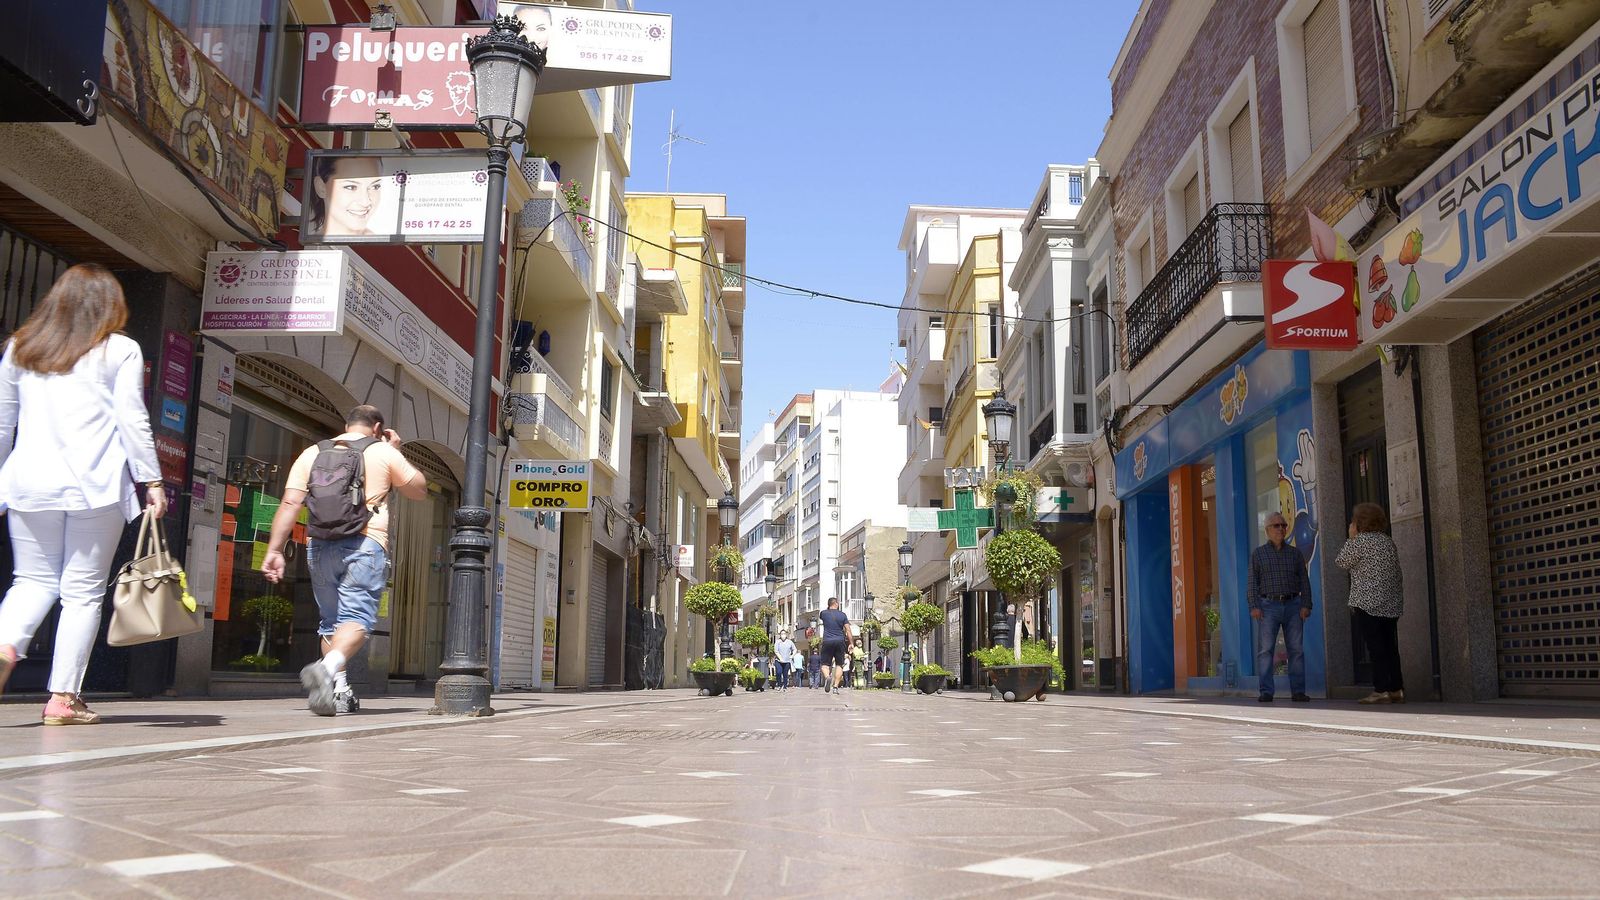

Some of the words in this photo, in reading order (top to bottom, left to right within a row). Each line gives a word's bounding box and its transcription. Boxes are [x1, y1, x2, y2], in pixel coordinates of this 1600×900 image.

[586, 18, 642, 30] GRUPODEN
[307, 32, 470, 71] Peluqueri
[580, 51, 598, 60] 956
[602, 53, 613, 61] 17
[76, 79, 98, 117] 3
[322, 84, 434, 110] FORMAS
[1438, 112, 1553, 221] SALON
[261, 259, 322, 268] GRUPODEN
[250, 270, 332, 280] DR.ESPINEL
[215, 295, 250, 304] Líderes
[265, 296, 292, 304] Salud
[1278, 325, 1348, 338] SPORTIUM
[515, 465, 552, 473] Phone
[558, 465, 584, 474] Gold
[944, 466, 986, 488] 12H
[516, 482, 582, 492] COMPRO
[532, 497, 564, 507] ORO
[1171, 484, 1180, 568] Planet
[1174, 576, 1183, 620] Toy
[544, 628, 554, 643] ORO
